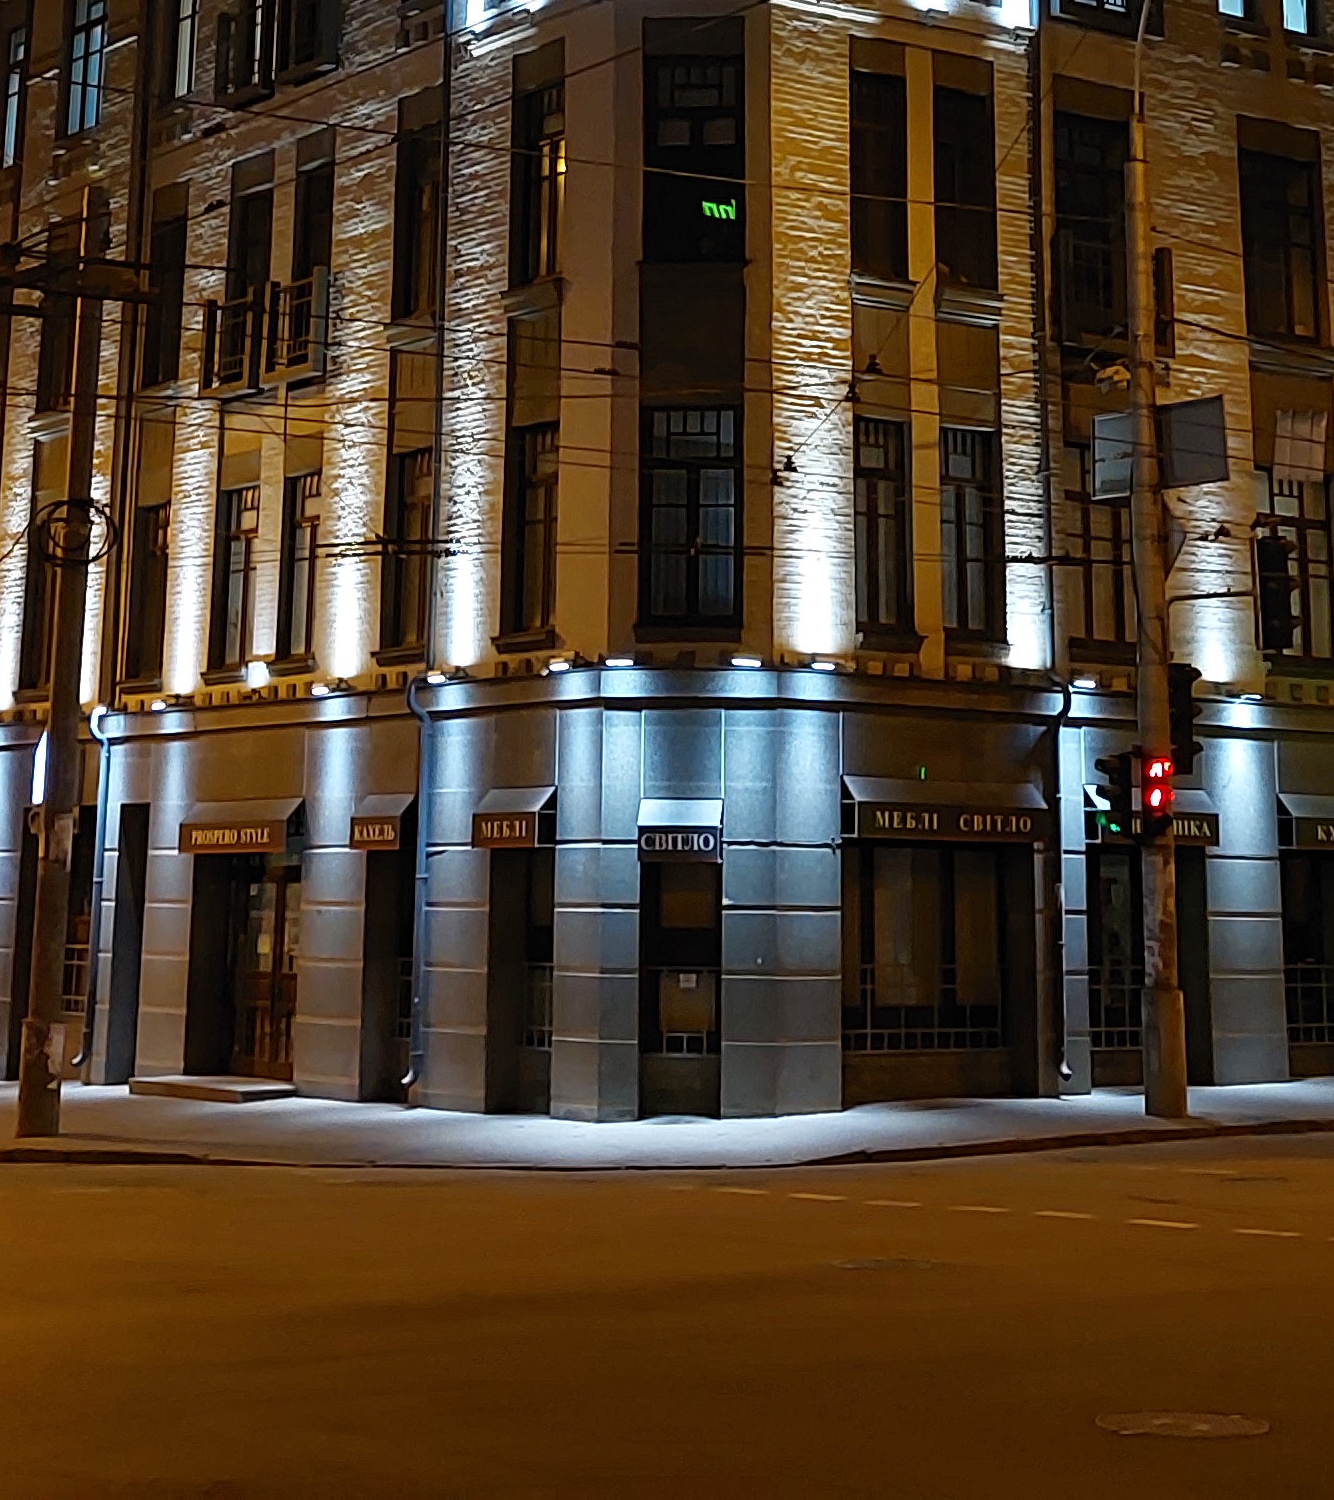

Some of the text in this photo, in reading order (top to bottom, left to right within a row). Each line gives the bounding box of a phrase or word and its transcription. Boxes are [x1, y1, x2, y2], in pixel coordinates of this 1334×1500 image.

[480, 819, 527, 839] МЕБЛІ
[875, 810, 1032, 833] МЕБЛІ СВІТЛО
[191, 827, 270, 845] PROSPERO STYLE
[353, 824, 395, 841] КАХЕЛЬ
[640, 832, 715, 851] СВІТЛО
